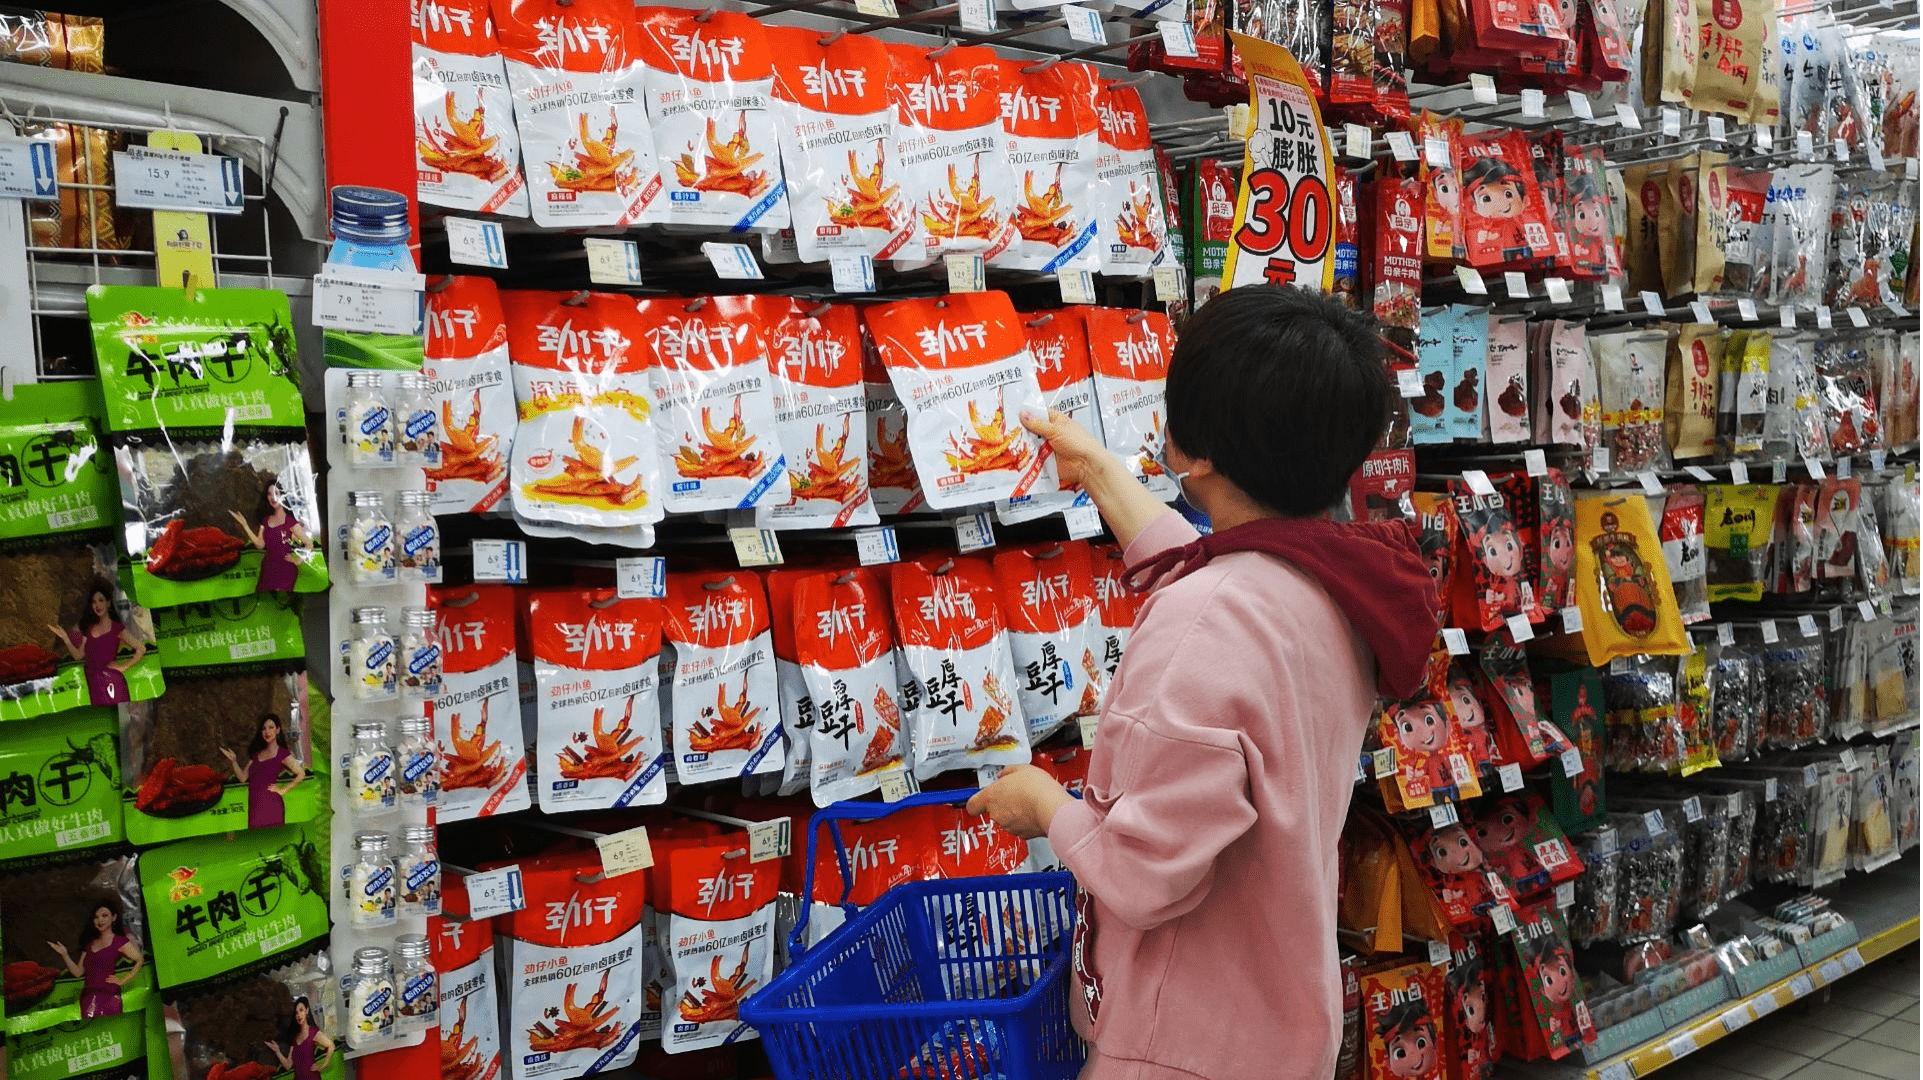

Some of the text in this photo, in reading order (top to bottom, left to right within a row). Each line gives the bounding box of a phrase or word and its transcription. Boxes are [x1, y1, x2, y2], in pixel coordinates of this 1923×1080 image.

[533, 16, 611, 67] 劲仔
[669, 28, 745, 76] 劲仔
[799, 57, 867, 111] 劲仔
[905, 73, 969, 124] 劲仔
[999, 84, 1062, 132] 劲仔
[1096, 100, 1137, 145] 劲仔
[1268, 98, 1315, 140] 10元
[147, 168, 170, 180] 15.9
[1271, 137, 1318, 175] 膨胀
[1233, 168, 1333, 264] 30
[337, 294, 352, 305] 7.9
[781, 329, 845, 382] 劲仔
[915, 319, 988, 368] 劲仔
[172, 390, 266, 412] 认真做好牛肉
[1362, 457, 1411, 478] 原切牛肉片
[1455, 491, 1504, 514] 王小卤
[917, 590, 977, 632] 劲仔
[1020, 570, 1070, 616] 劲仔
[178, 625, 271, 652] 认真做好牛肉
[565, 614, 636, 667] 劲仔
[684, 594, 745, 646] 劲仔
[816, 598, 867, 650] 劲仔
[613, 850, 625, 860] 6.9
[940, 820, 997, 868] 劲仔
[176, 871, 278, 943] 牛肉干
[484, 887, 496, 898] 6.9
[696, 867, 755, 918] 劲仔
[216, 914, 297, 959] 认真做好牛肉
[545, 889, 618, 944] 劲仔
[678, 929, 716, 947] 劲仔小鱼
[1515, 917, 1554, 944] 王小卤
[677, 922, 768, 959] 全球热销60亿包的卤味零食
[523, 946, 633, 987] 全球热销60亿包的卤味零食
[524, 956, 569, 975] 劲仔小鱼
[1370, 982, 1423, 1012] 王小卤
[12, 1031, 114, 1074] 认真做好牛肉
